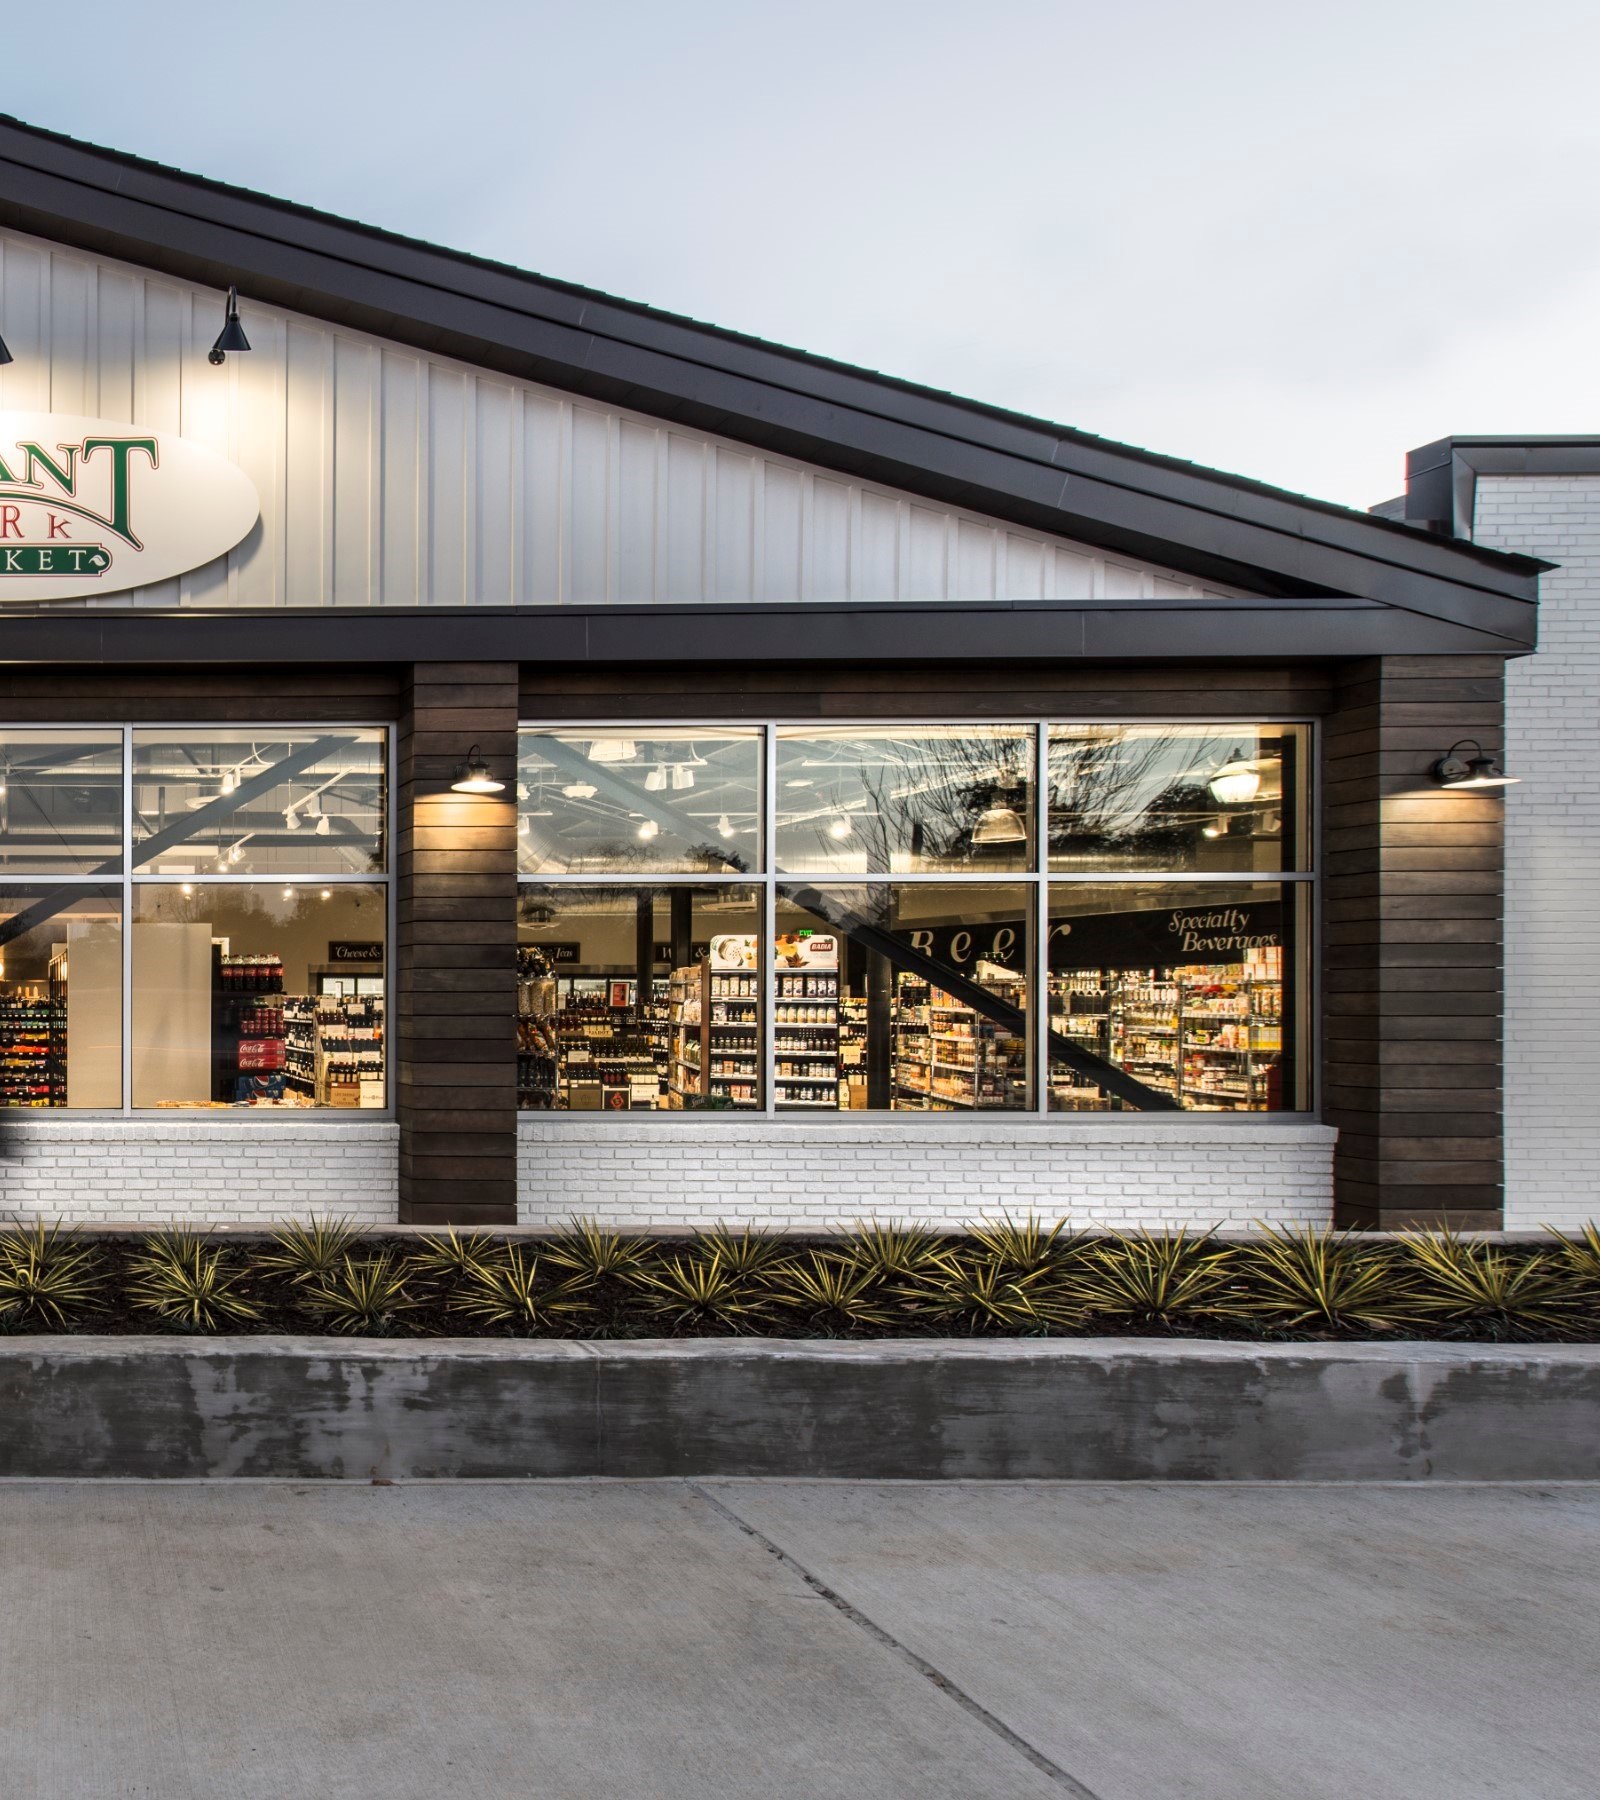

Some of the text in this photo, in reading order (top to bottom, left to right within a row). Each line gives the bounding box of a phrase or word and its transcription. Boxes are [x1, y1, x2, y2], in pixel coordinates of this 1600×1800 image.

[1168, 909, 1250, 936] Specialty
[336, 946, 368, 958] Cheese
[1181, 931, 1278, 952] Beverages
